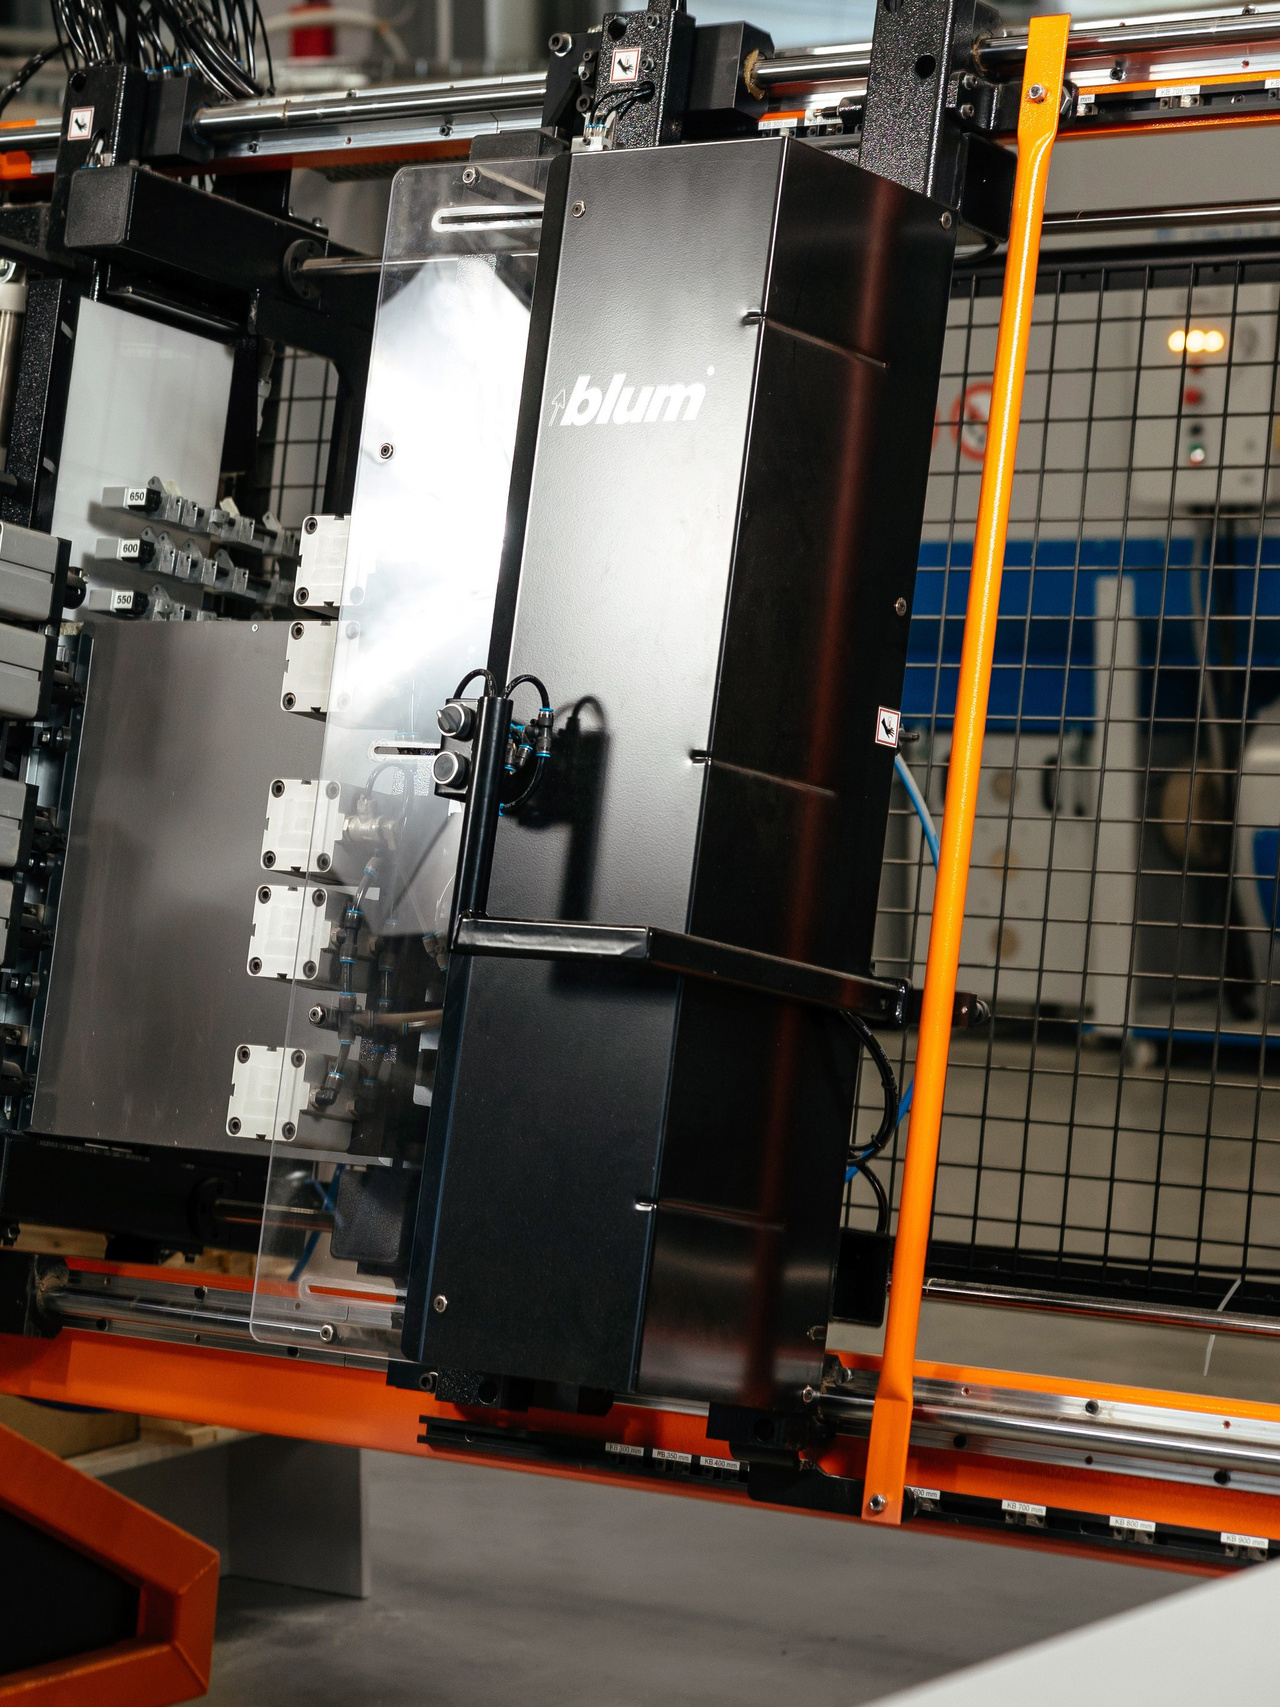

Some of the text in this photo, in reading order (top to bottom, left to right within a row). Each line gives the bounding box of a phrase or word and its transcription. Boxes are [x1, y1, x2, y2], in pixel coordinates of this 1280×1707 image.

[1172, 87, 1184, 95] 700
[560, 371, 708, 427] blum
[129, 492, 145, 501] 650
[123, 543, 138, 553] 600
[116, 595, 132, 604] 550
[620, 1445, 629, 1453] 300
[667, 1452, 677, 1460] 350
[714, 1460, 725, 1468] 400
[1007, 1502, 1043, 1514] KB 700 mm
[1115, 1518, 1152, 1530] KB 800 mm
[1226, 1535, 1265, 1547] KB 900 mm
